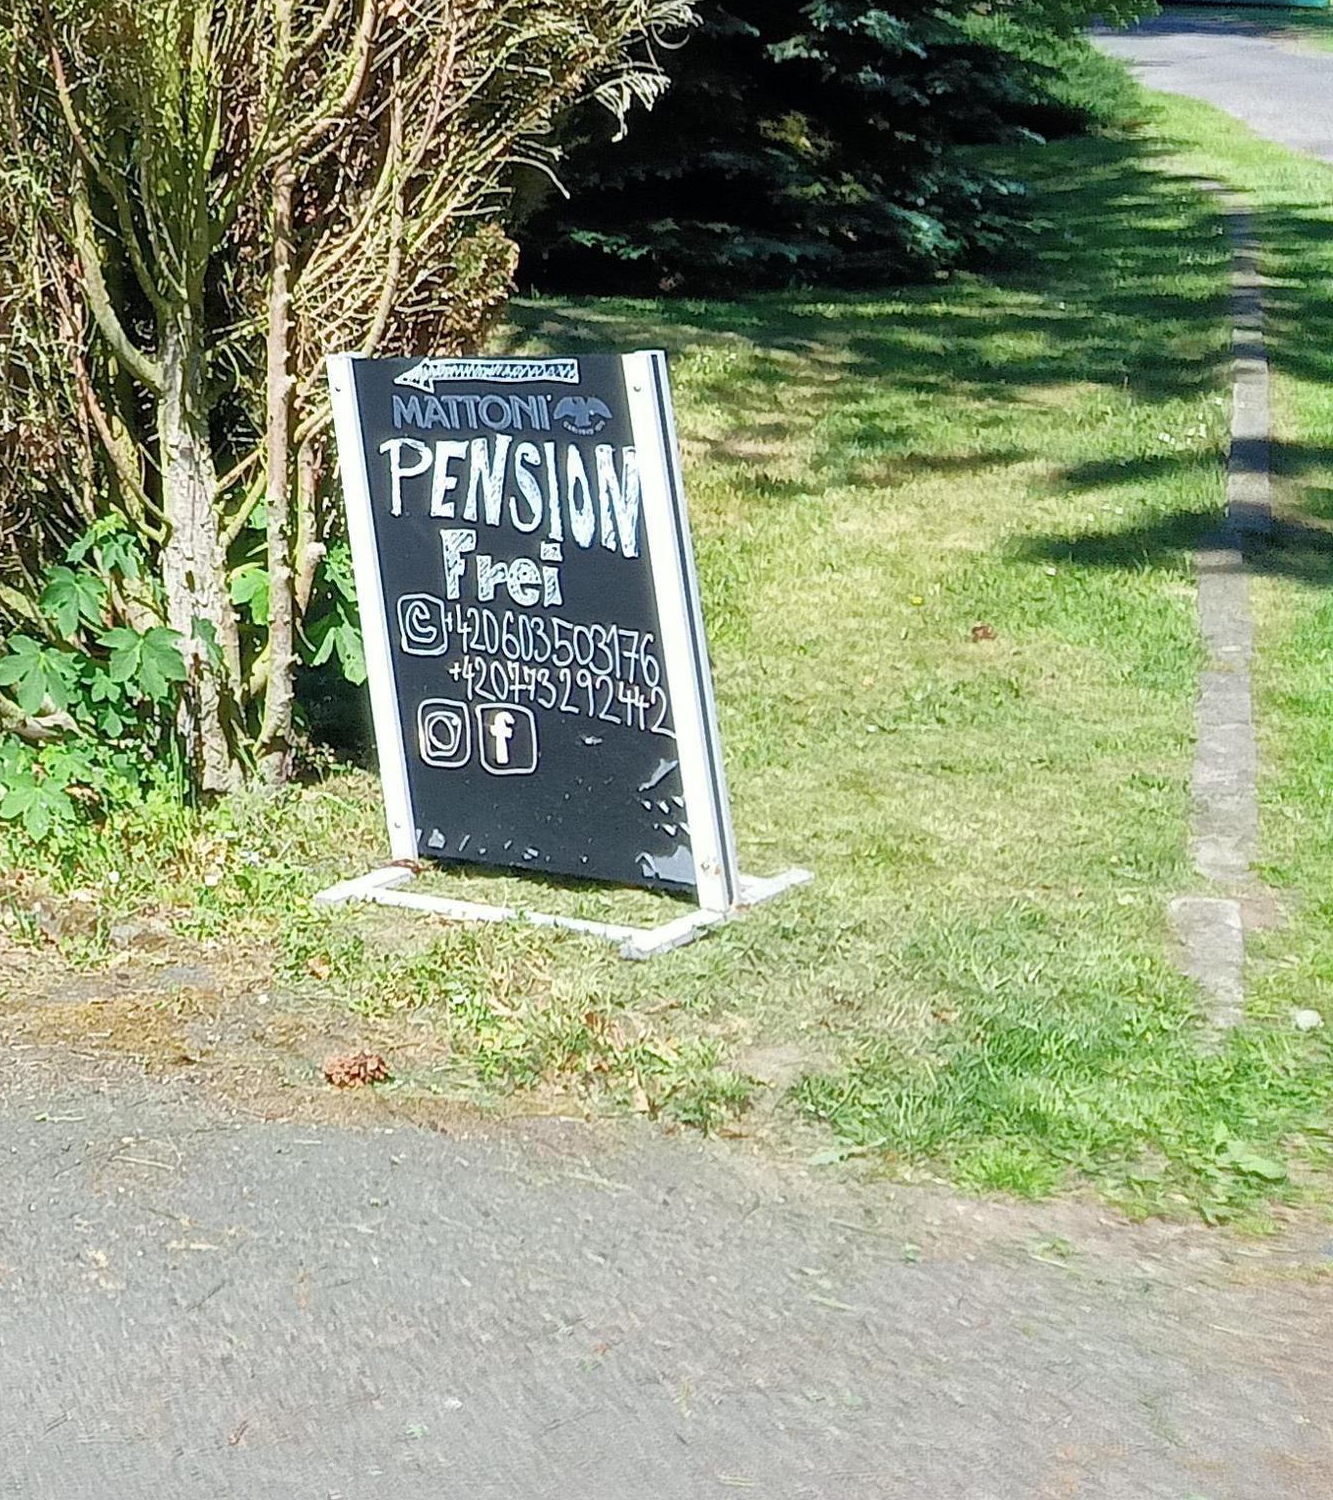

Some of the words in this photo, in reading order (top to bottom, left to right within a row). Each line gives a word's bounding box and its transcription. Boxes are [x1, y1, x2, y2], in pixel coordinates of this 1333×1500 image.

[392, 394, 551, 431] MATTONI
[379, 433, 640, 559] PENSION
[440, 528, 564, 608] Frei
